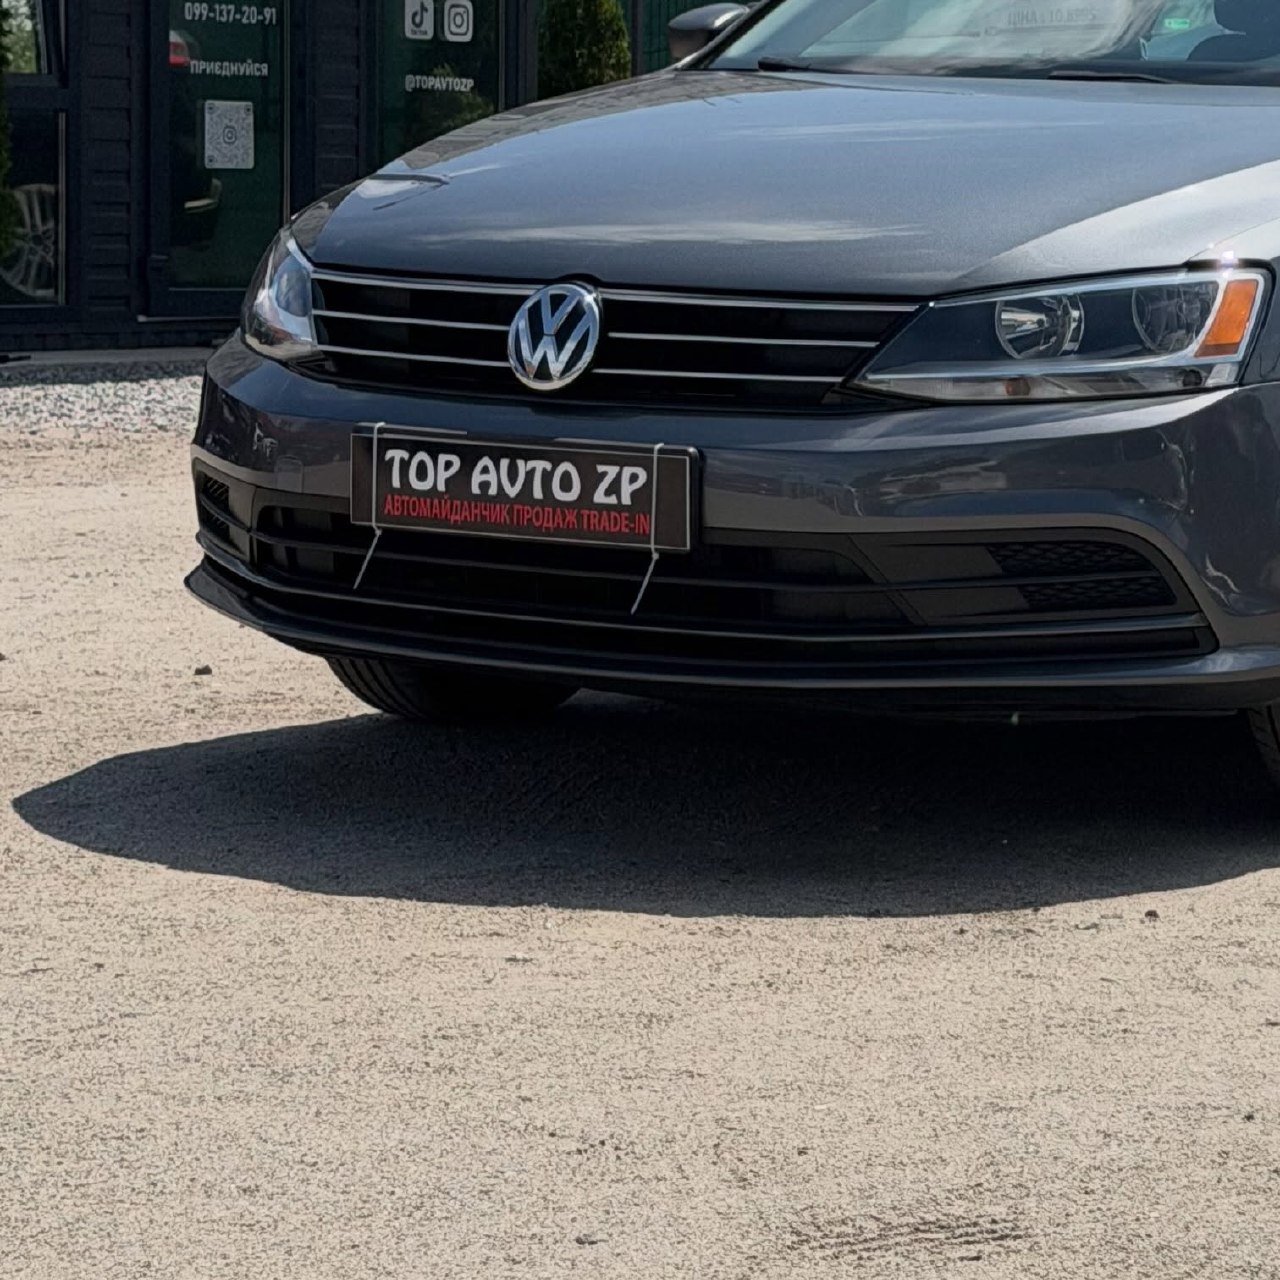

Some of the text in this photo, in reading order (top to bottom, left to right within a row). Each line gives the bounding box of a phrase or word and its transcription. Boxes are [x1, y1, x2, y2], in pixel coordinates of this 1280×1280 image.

[184, 2, 277, 25] 099-137-20-91
[190, 59, 268, 77] ПРИЄДНУЙСЯ
[384, 449, 461, 492] TOP
[592, 464, 648, 505] ZP
[384, 494, 650, 535] АВТОМАЙДАНЧИК ПРОДАЖ TRADE-IN
